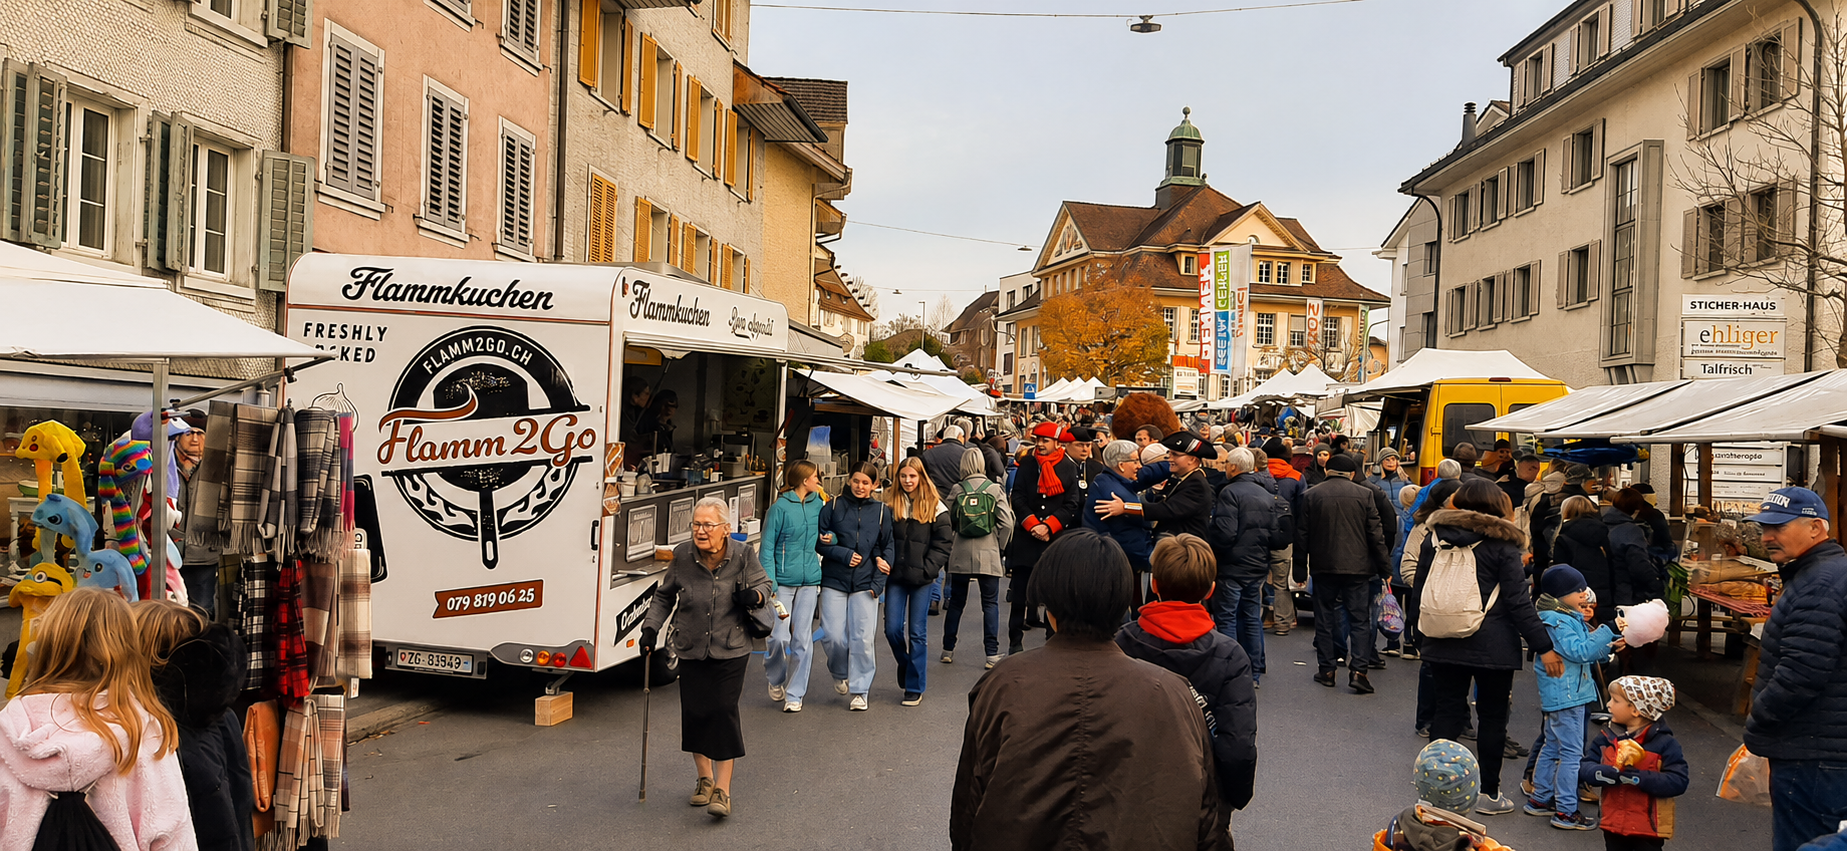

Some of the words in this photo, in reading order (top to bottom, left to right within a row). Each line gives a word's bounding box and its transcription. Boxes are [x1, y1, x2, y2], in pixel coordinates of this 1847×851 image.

[341, 266, 554, 311] Flammkuchen
[629, 279, 711, 327] Flammkuchen
[1689, 300, 1777, 310] STICHER-HAUS
[303, 322, 388, 342] FRESHLY
[1699, 324, 1779, 350] ehliger
[313, 343, 376, 363] KED
[422, 336, 533, 375] FLAMM2GO.CH
[1700, 363, 1753, 375] Talfrisch
[446, 595, 471, 611] 079
[473, 592, 497, 608] 819
[498, 588, 516, 605] 06
[517, 587, 535, 603] 25
